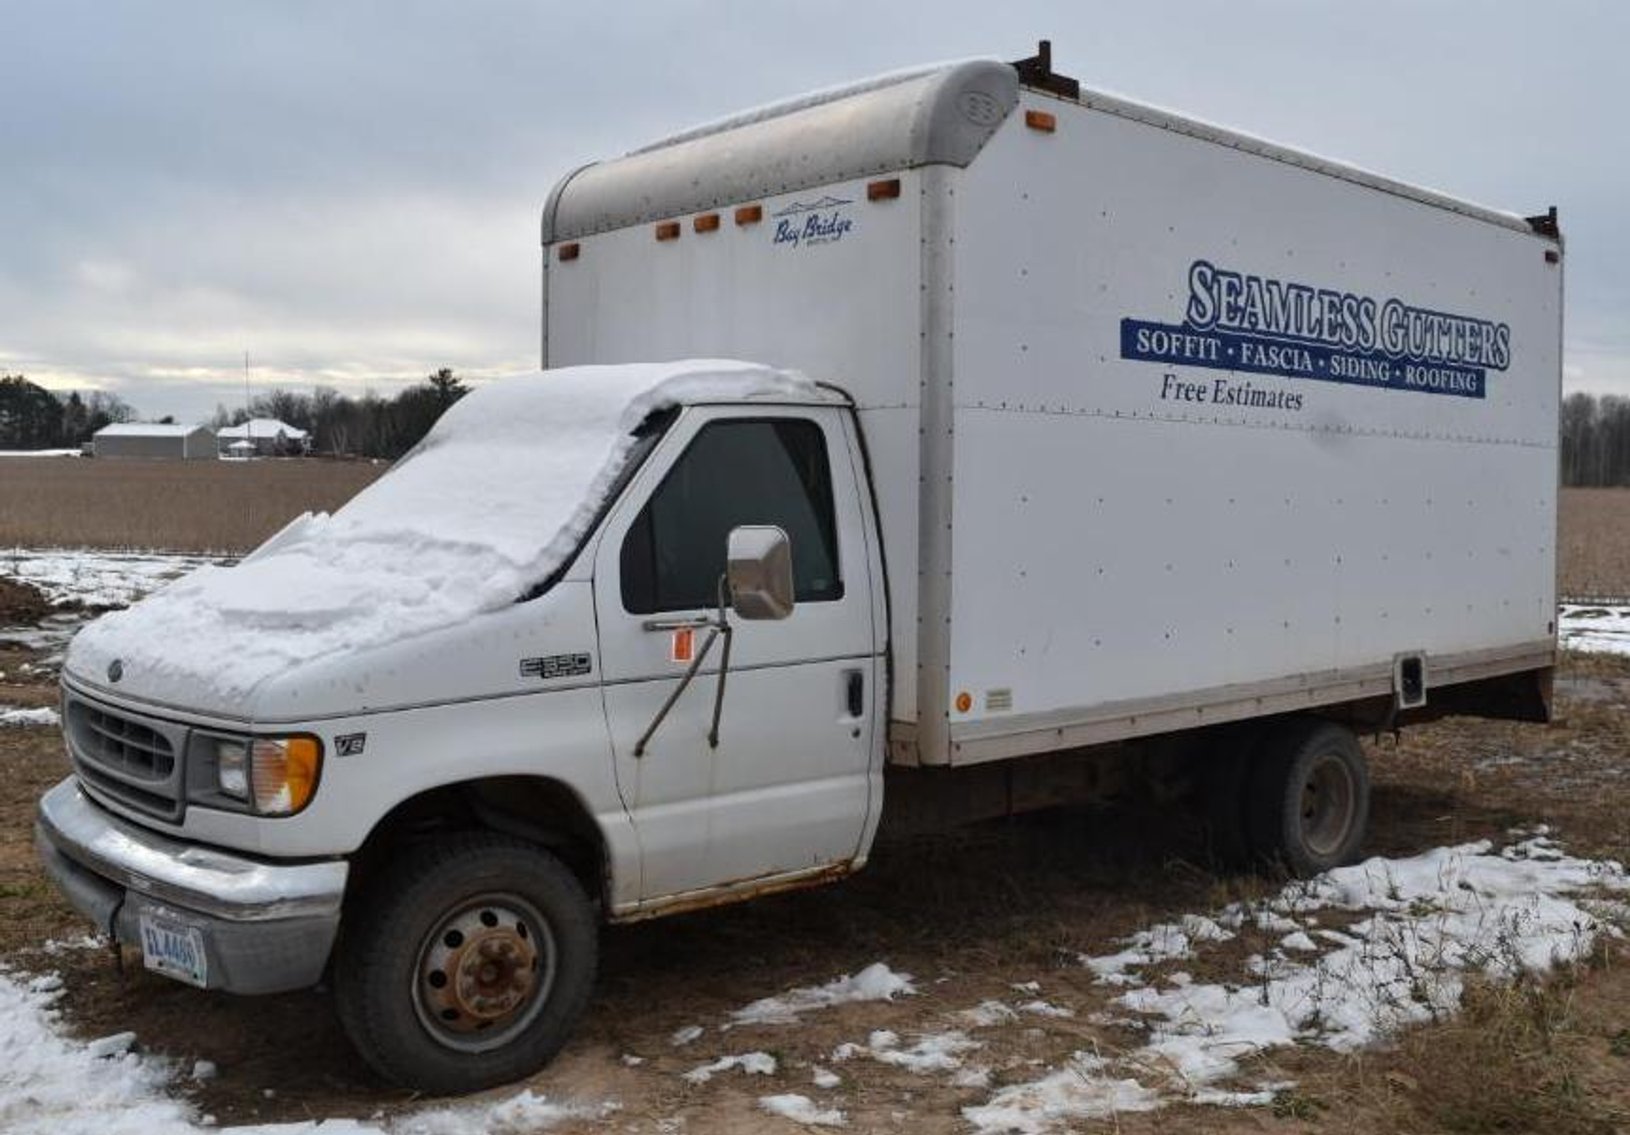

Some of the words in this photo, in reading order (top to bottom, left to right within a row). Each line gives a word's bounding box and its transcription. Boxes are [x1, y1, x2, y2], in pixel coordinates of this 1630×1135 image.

[774, 219, 799, 248] Bay
[802, 211, 852, 240] Bridge
[1187, 260, 1377, 354] SEAMLESS
[1381, 298, 1510, 372] GUTTERS
[1136, 328, 1221, 360] SOFFIT
[1241, 342, 1314, 371] FASCIA
[1330, 354, 1390, 381] SIDING
[1405, 364, 1477, 391] ROOFING
[1161, 373, 1207, 402] Free
[1210, 379, 1304, 411] Estimates
